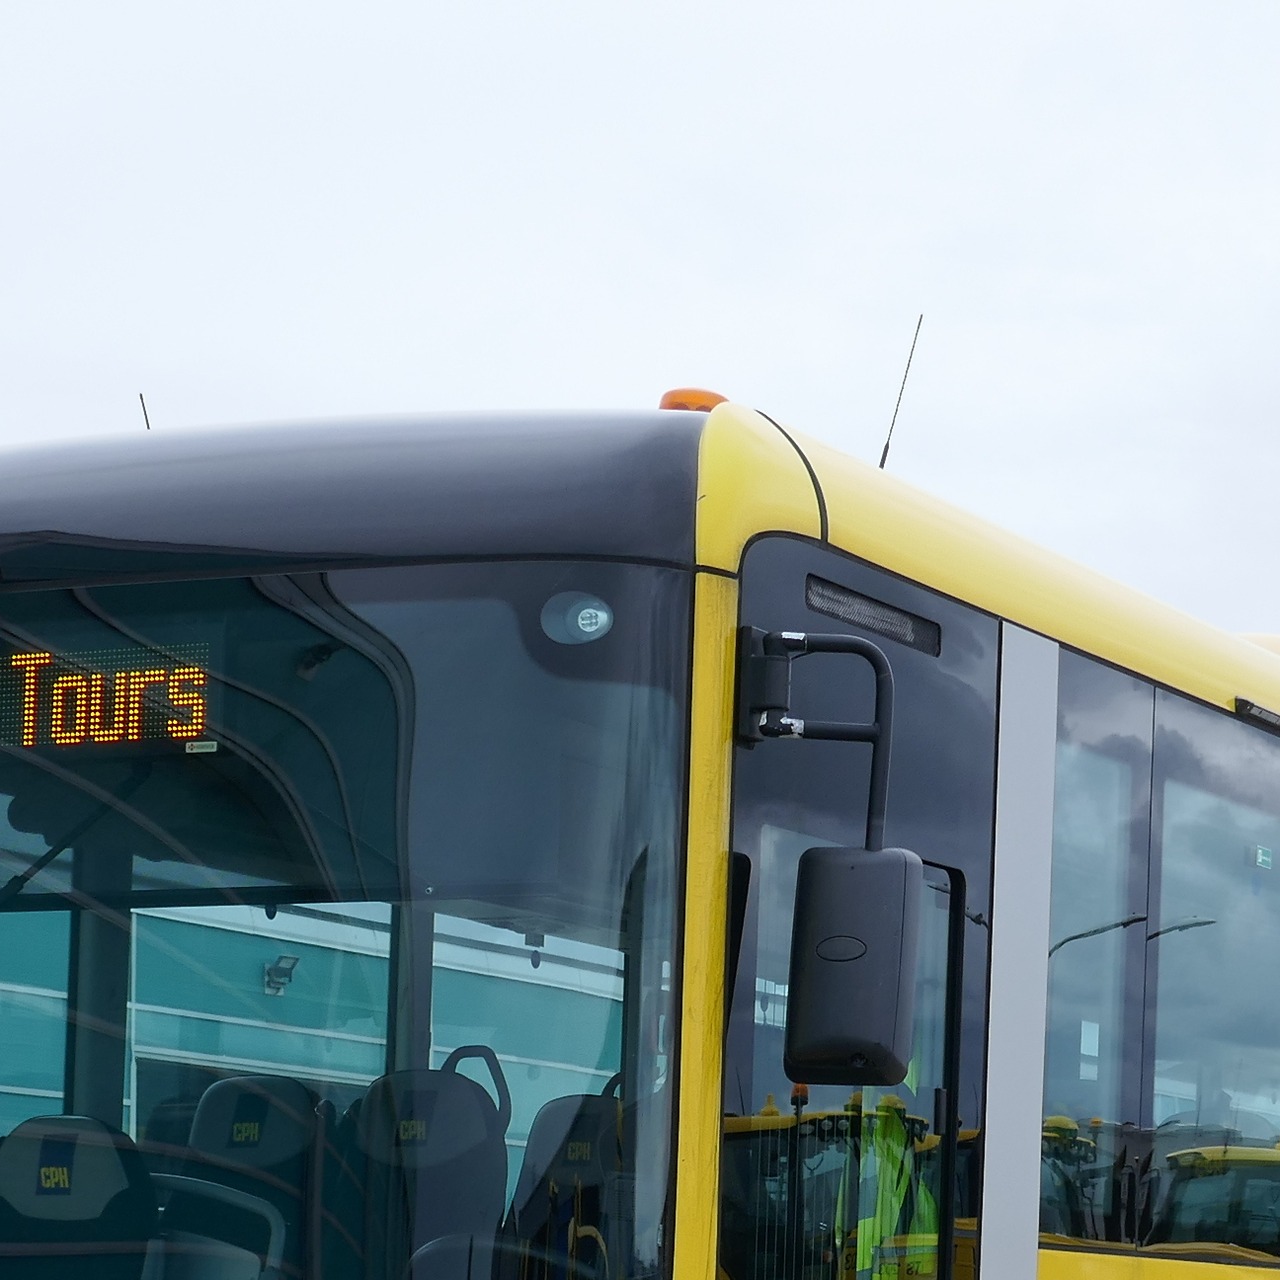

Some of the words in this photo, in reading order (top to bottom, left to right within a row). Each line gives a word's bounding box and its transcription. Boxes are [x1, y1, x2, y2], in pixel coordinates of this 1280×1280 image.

[11, 652, 207, 747] Tours
[232, 1121, 259, 1142] CPH
[399, 1120, 426, 1140] CPH
[40, 1166, 69, 1188] CPH
